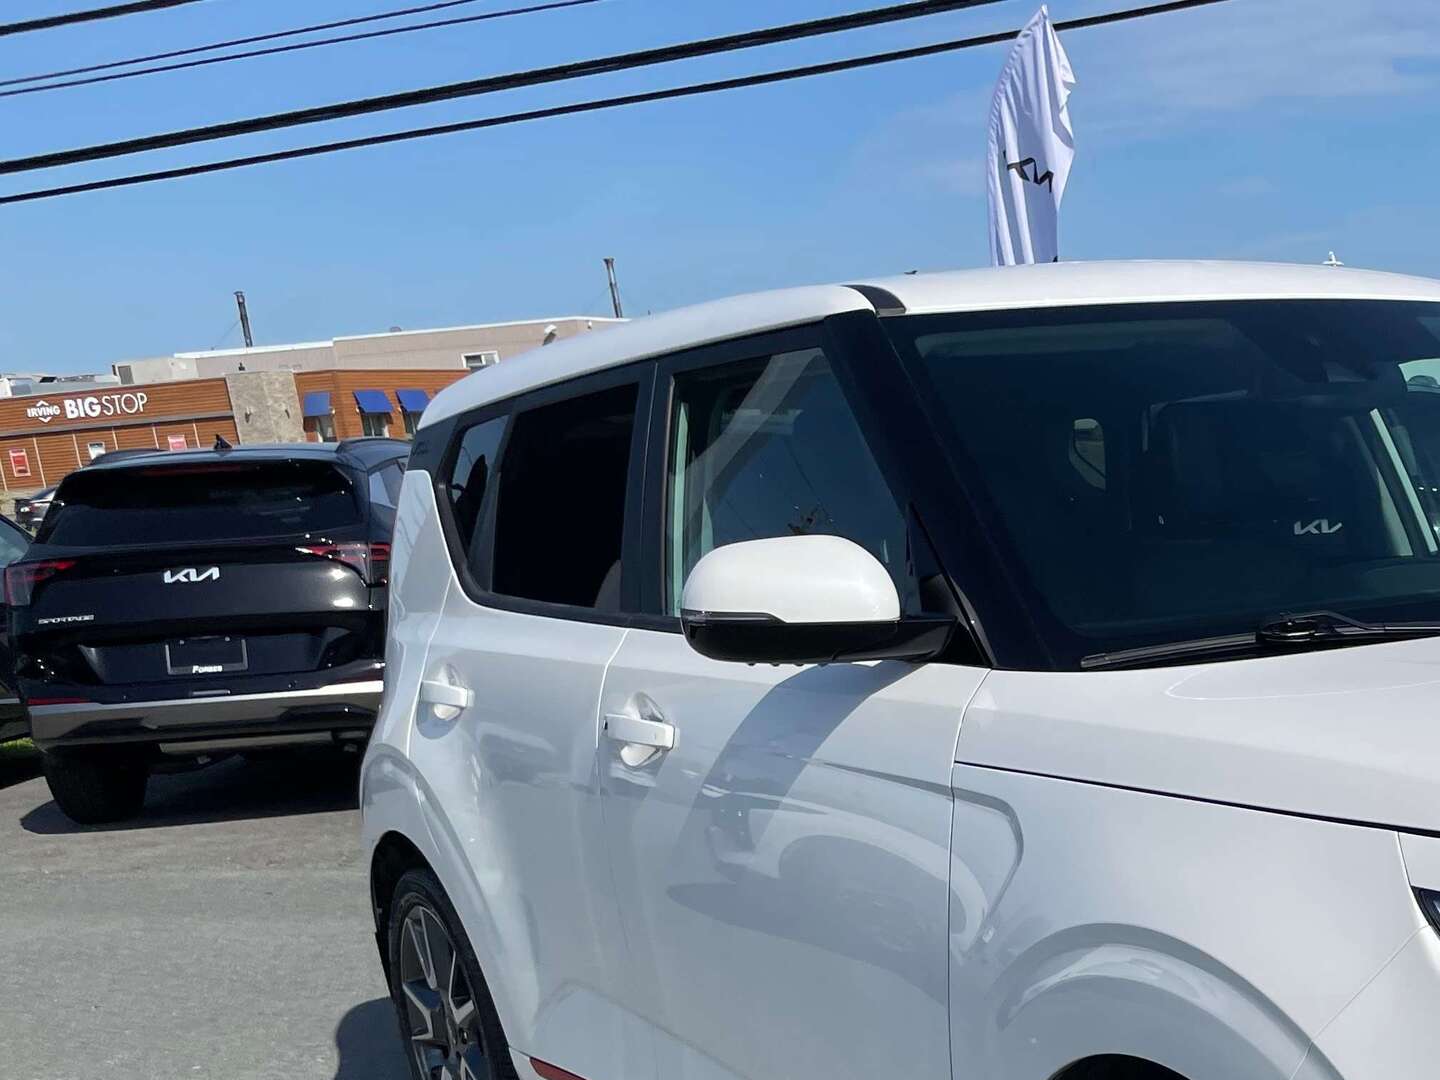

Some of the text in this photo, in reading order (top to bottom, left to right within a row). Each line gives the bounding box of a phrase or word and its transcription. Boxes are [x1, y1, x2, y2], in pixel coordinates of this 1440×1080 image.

[26, 392, 148, 419] IRVING BIG STOP
[163, 566, 220, 584] KIA
